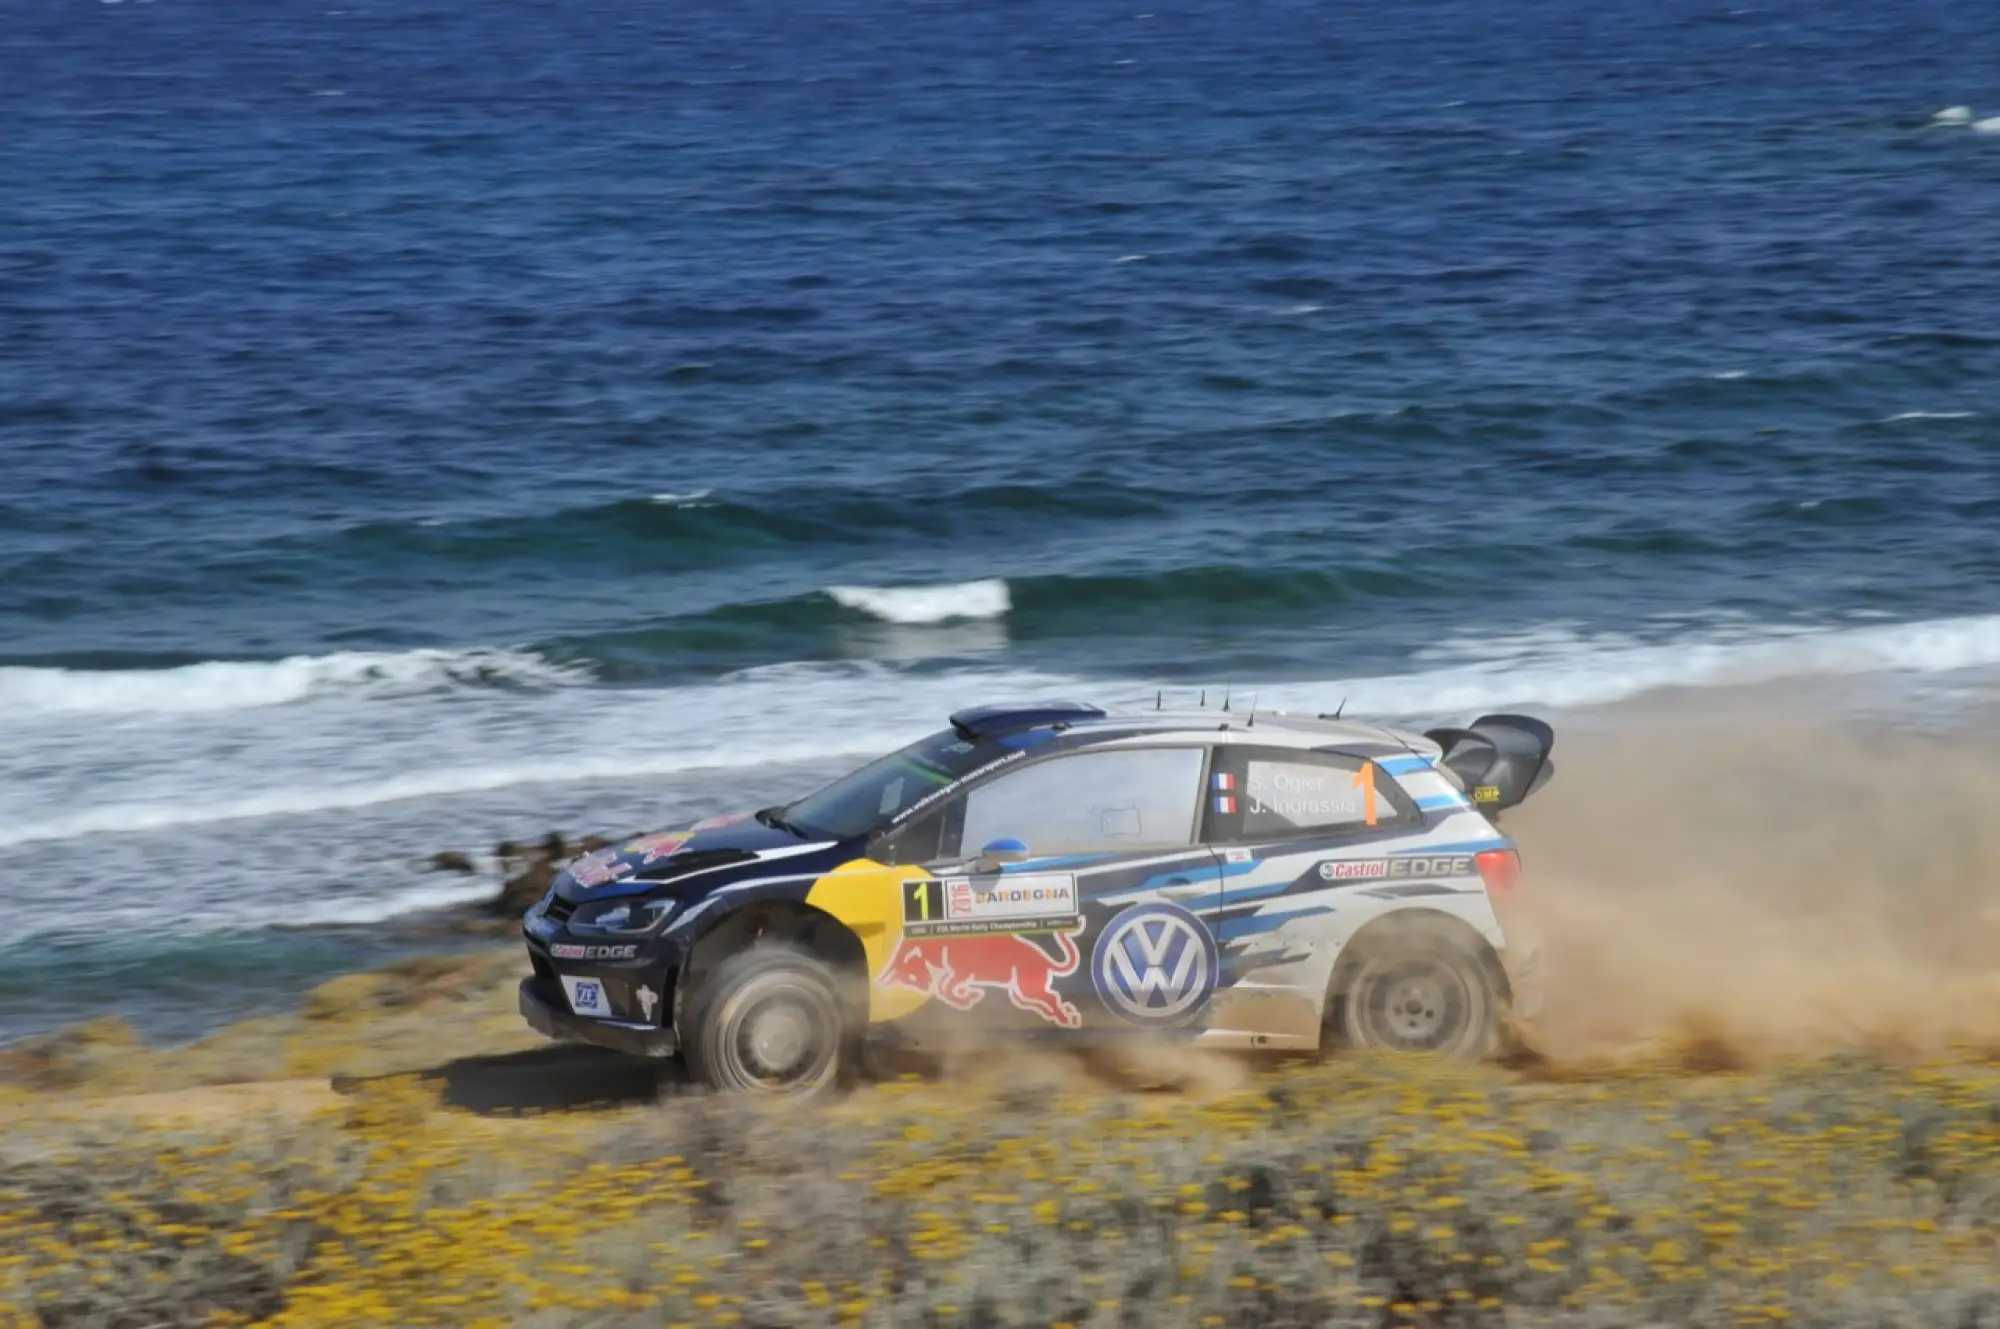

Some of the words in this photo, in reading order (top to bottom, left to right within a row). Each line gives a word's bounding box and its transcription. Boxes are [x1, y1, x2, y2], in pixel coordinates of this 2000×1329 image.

[1273, 774, 1325, 793] Ogier
[1353, 761, 1378, 825] 1
[1250, 799, 1267, 814] J.
[1273, 796, 1357, 818] Ingrassia
[1335, 861, 1386, 878] Castrol
[1390, 858, 1471, 877] EDGE
[913, 881, 929, 920] 1
[975, 887, 1070, 905] SARDEGNA
[585, 945, 638, 958] EDGE
